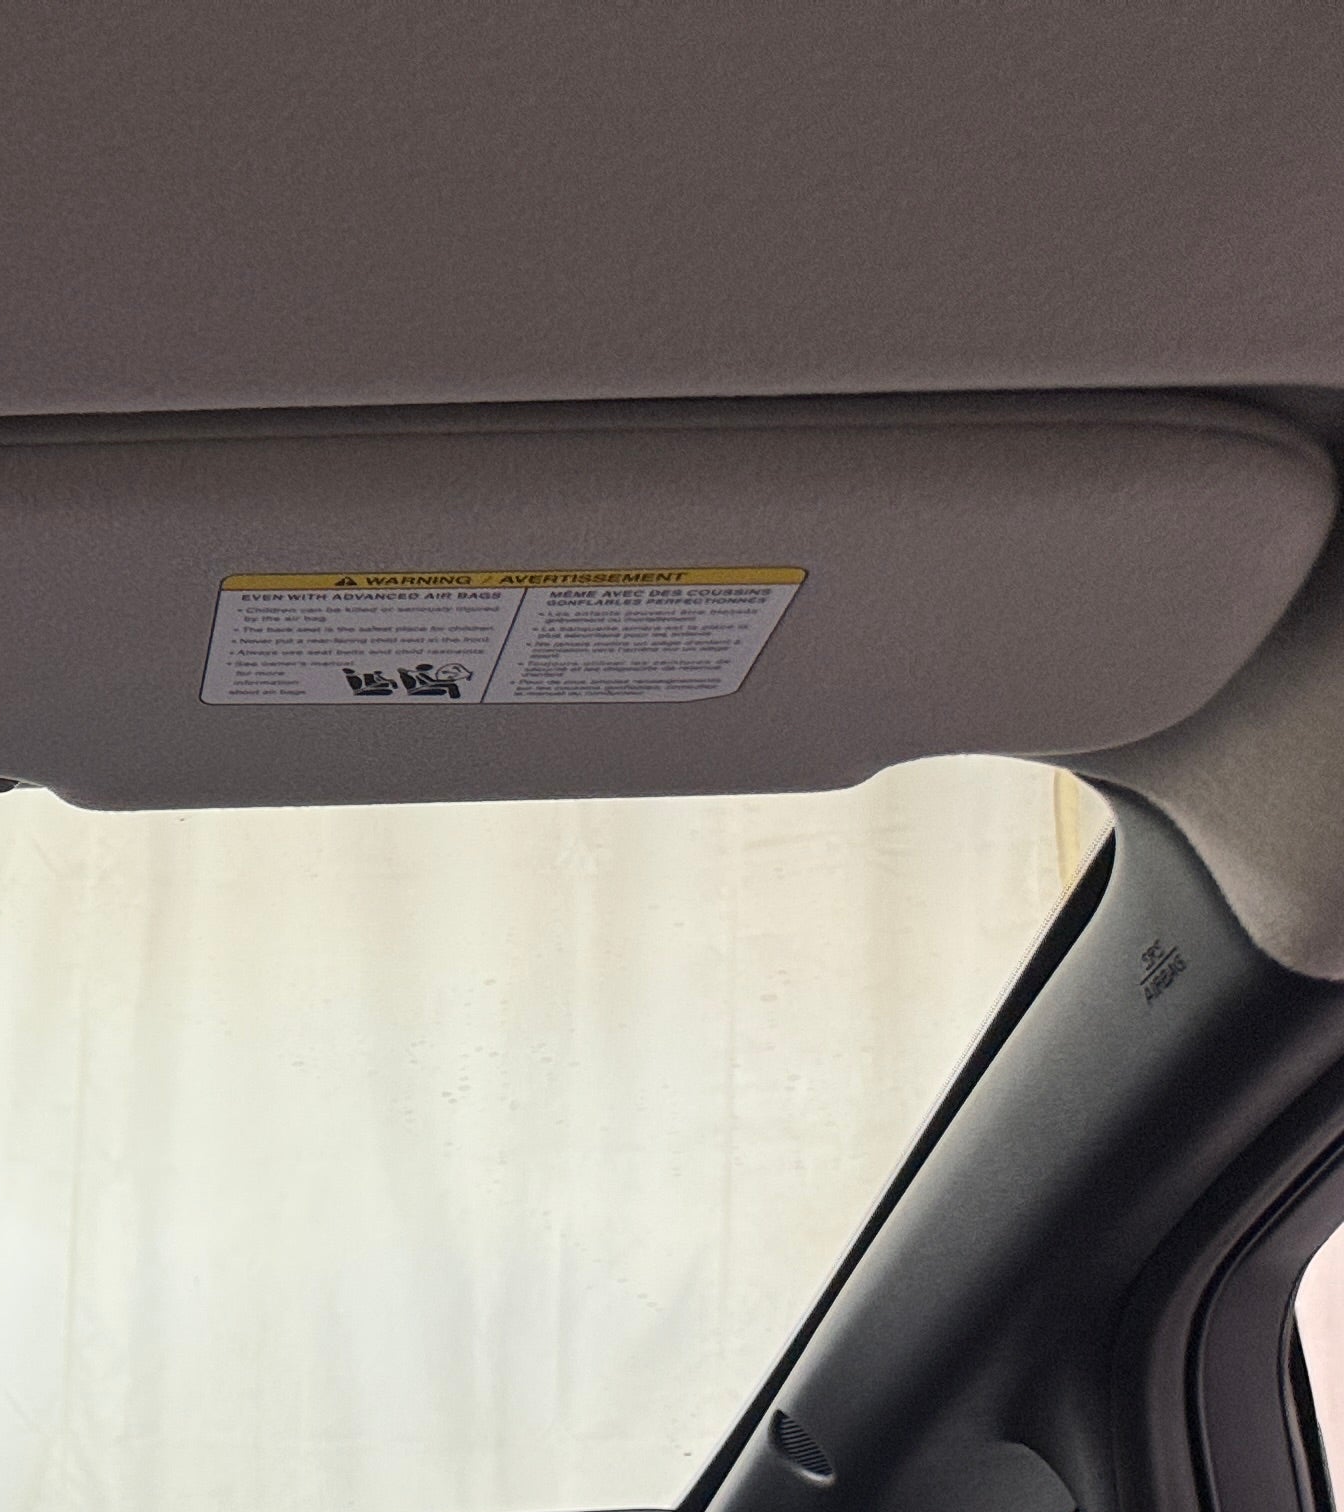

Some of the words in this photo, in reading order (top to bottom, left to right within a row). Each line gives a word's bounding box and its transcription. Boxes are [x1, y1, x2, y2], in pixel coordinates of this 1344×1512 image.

[365, 575, 473, 586] WARNING
[499, 572, 688, 586] AVERTISSEMENT
[241, 593, 285, 601] EVEN
[287, 593, 328, 601] WITH
[332, 592, 421, 601] ADVANCED
[424, 592, 453, 600] AIR
[458, 591, 502, 600] BAGS
[602, 588, 645, 598] AVEC
[650, 588, 683, 597] DES
